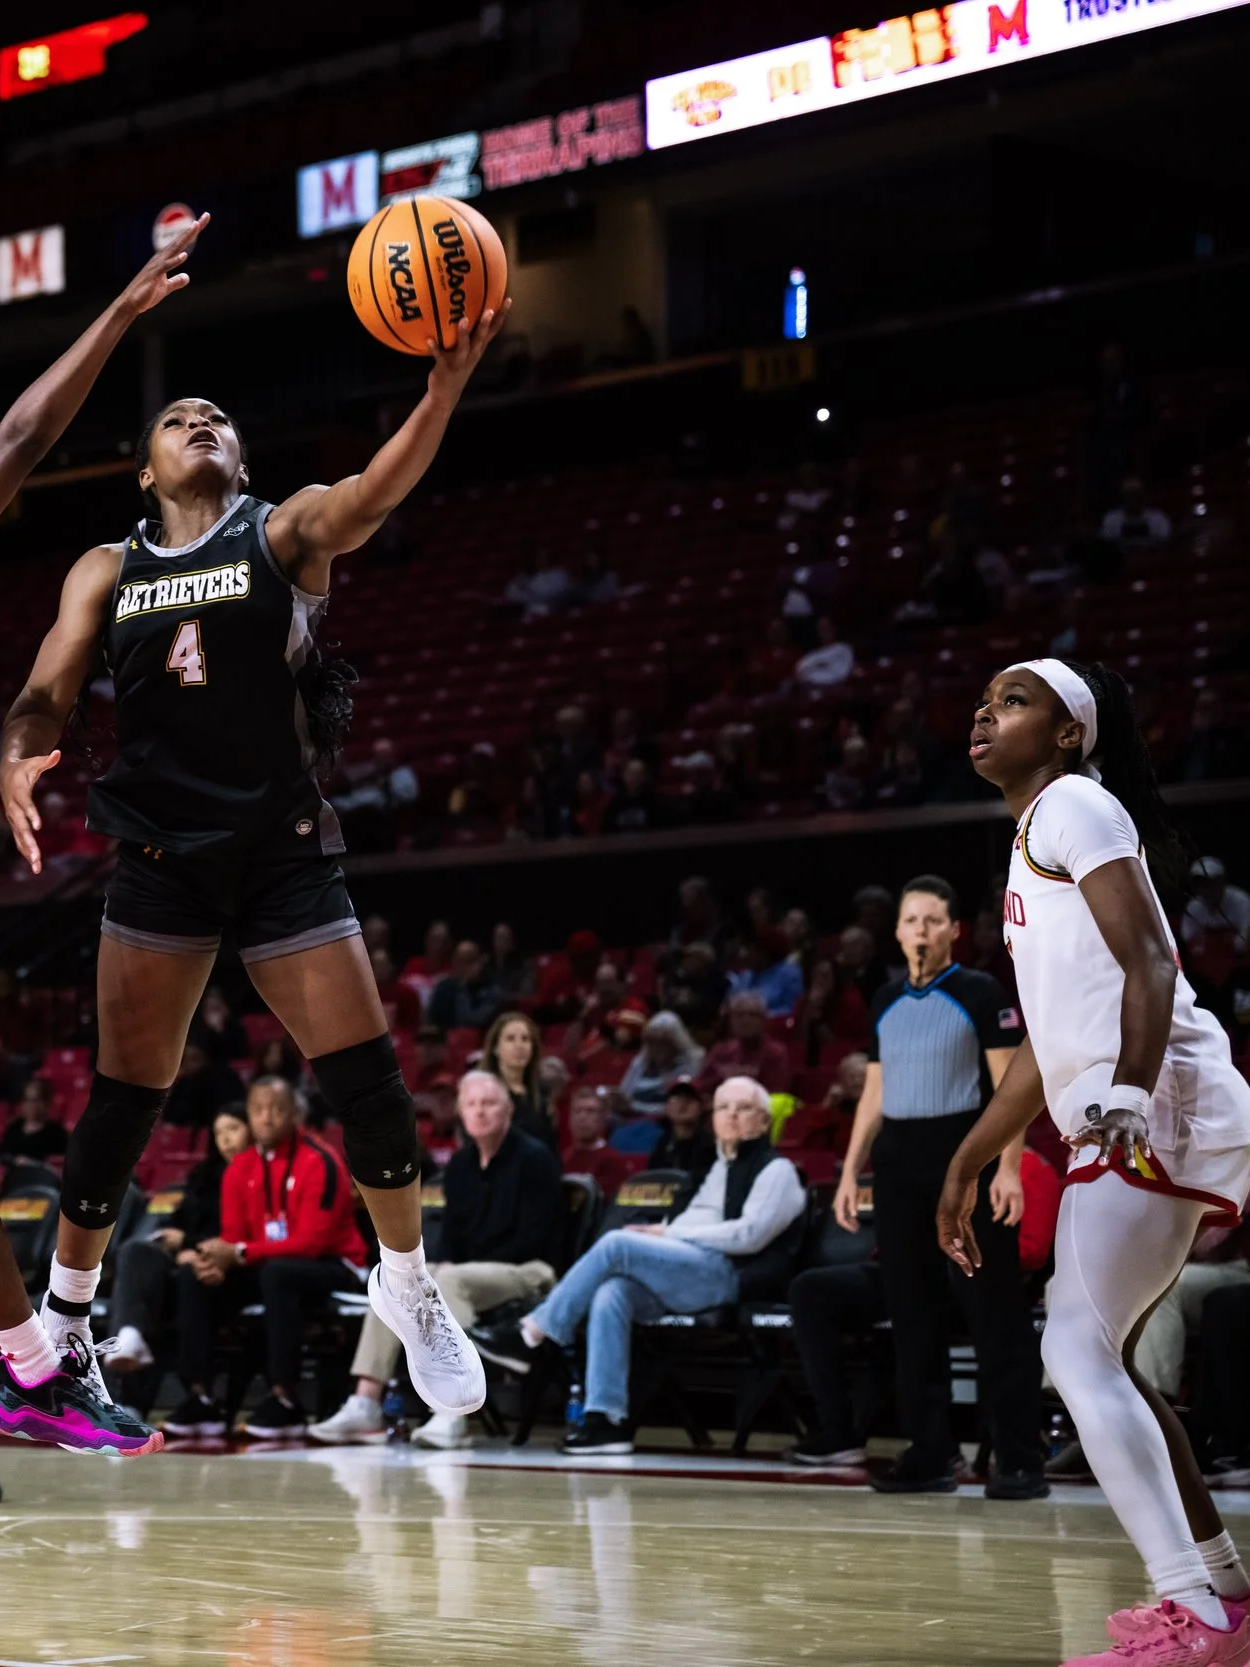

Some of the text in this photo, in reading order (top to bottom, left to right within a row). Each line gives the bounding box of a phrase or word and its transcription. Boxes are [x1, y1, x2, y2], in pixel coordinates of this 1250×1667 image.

[987, 0, 1029, 53] M
[388, 242, 423, 322] NCAA
[433, 218, 471, 326] Wilson
[166, 620, 206, 686] 4
